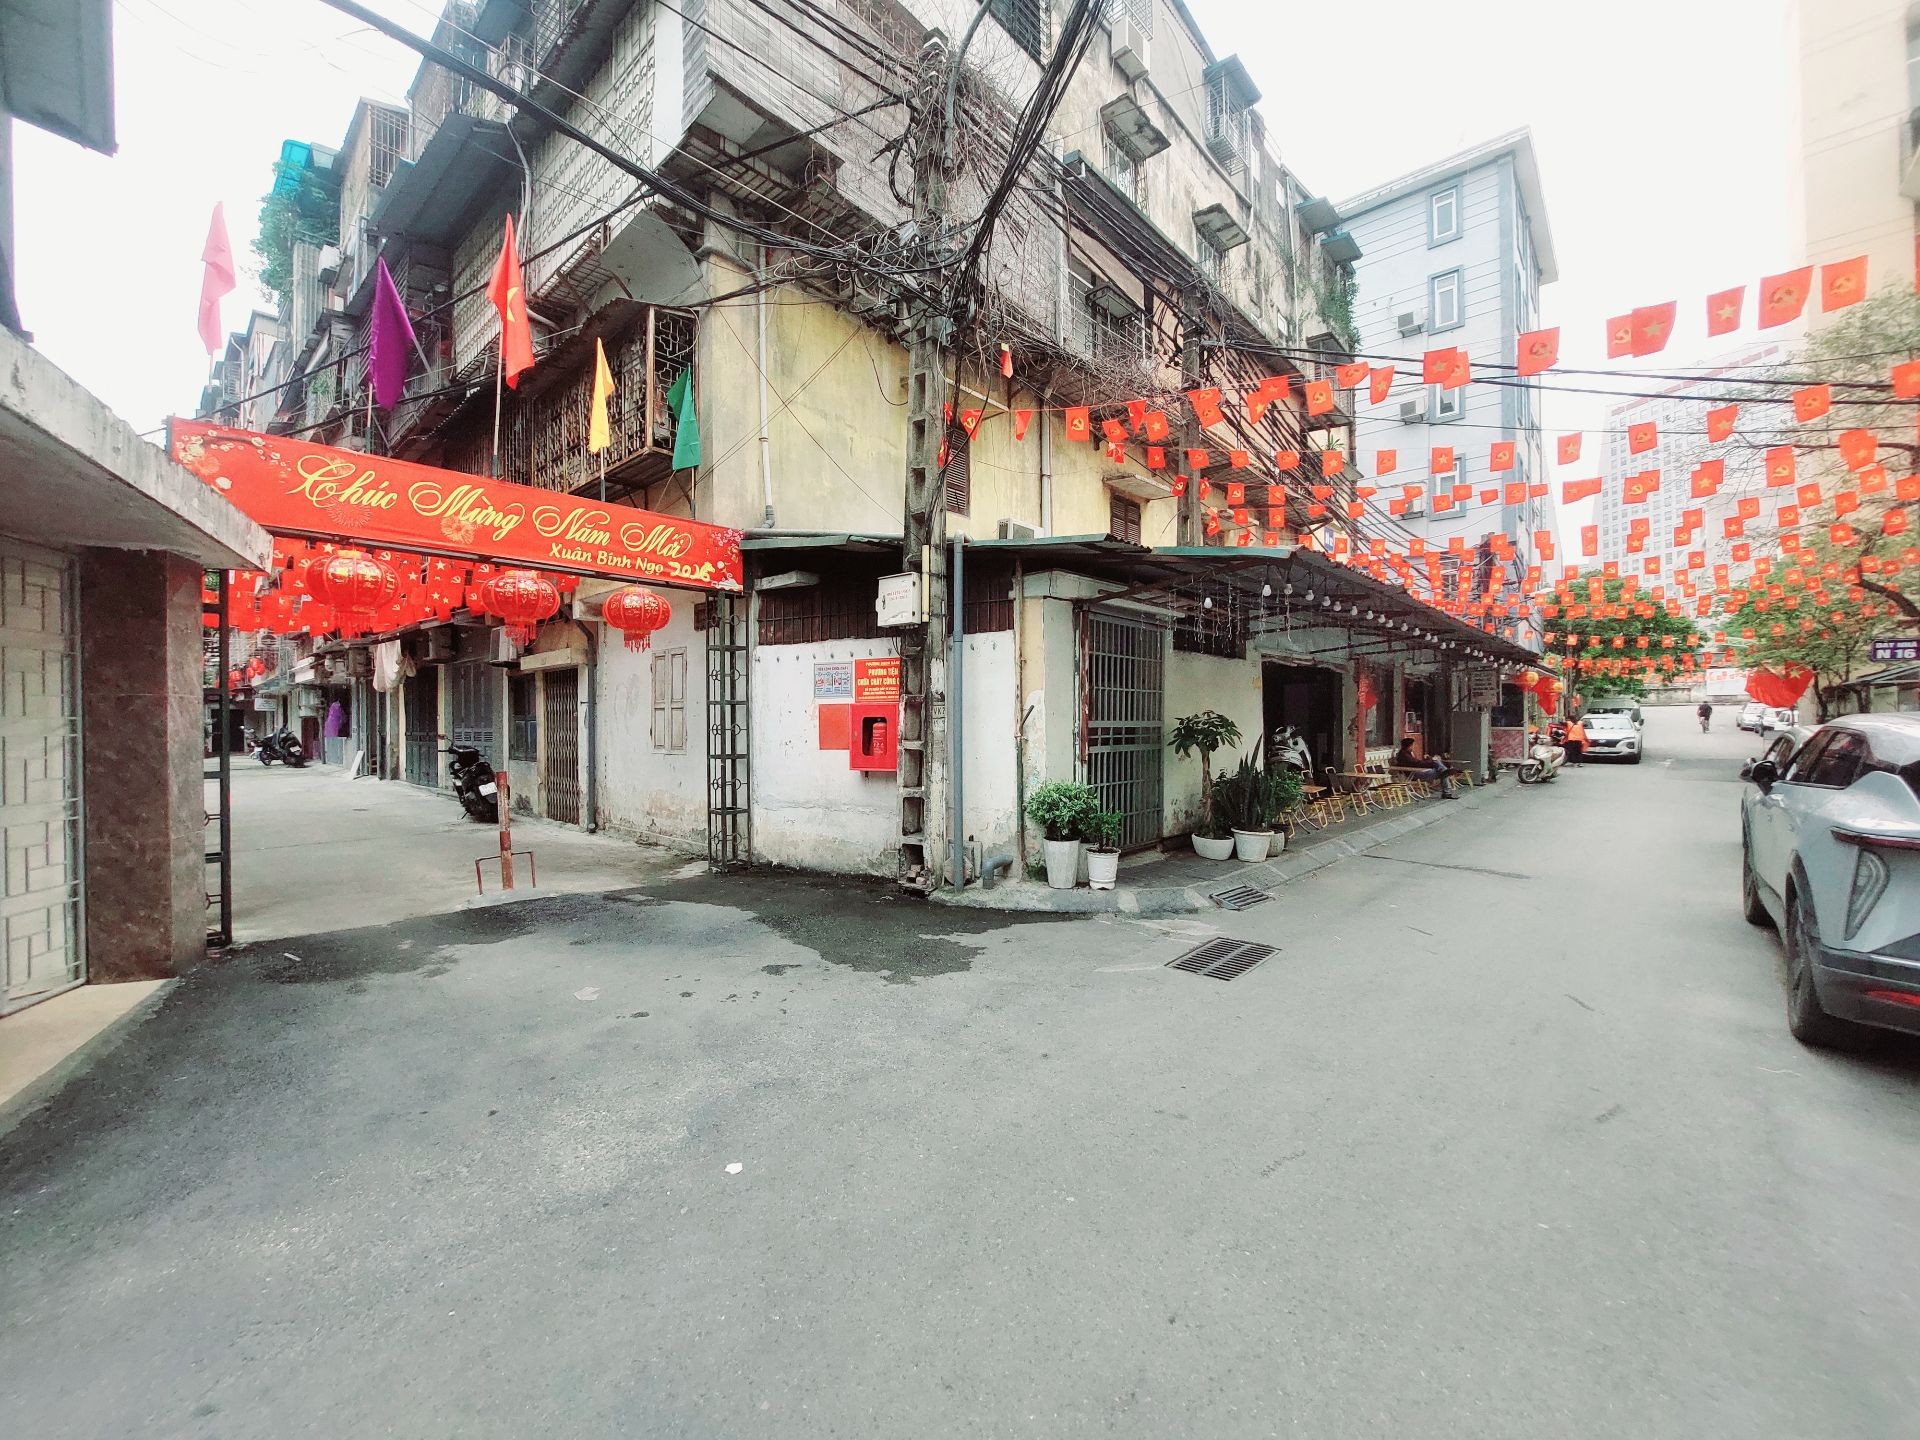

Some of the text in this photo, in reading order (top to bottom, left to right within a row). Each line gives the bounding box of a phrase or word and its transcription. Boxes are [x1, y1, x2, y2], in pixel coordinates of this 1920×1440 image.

[286, 454, 692, 558] Chúc Mừng Năm Mới
[550, 542, 715, 583] Xuân Bính Ngọ 2026
[1876, 649, 1917, 659] N 16
